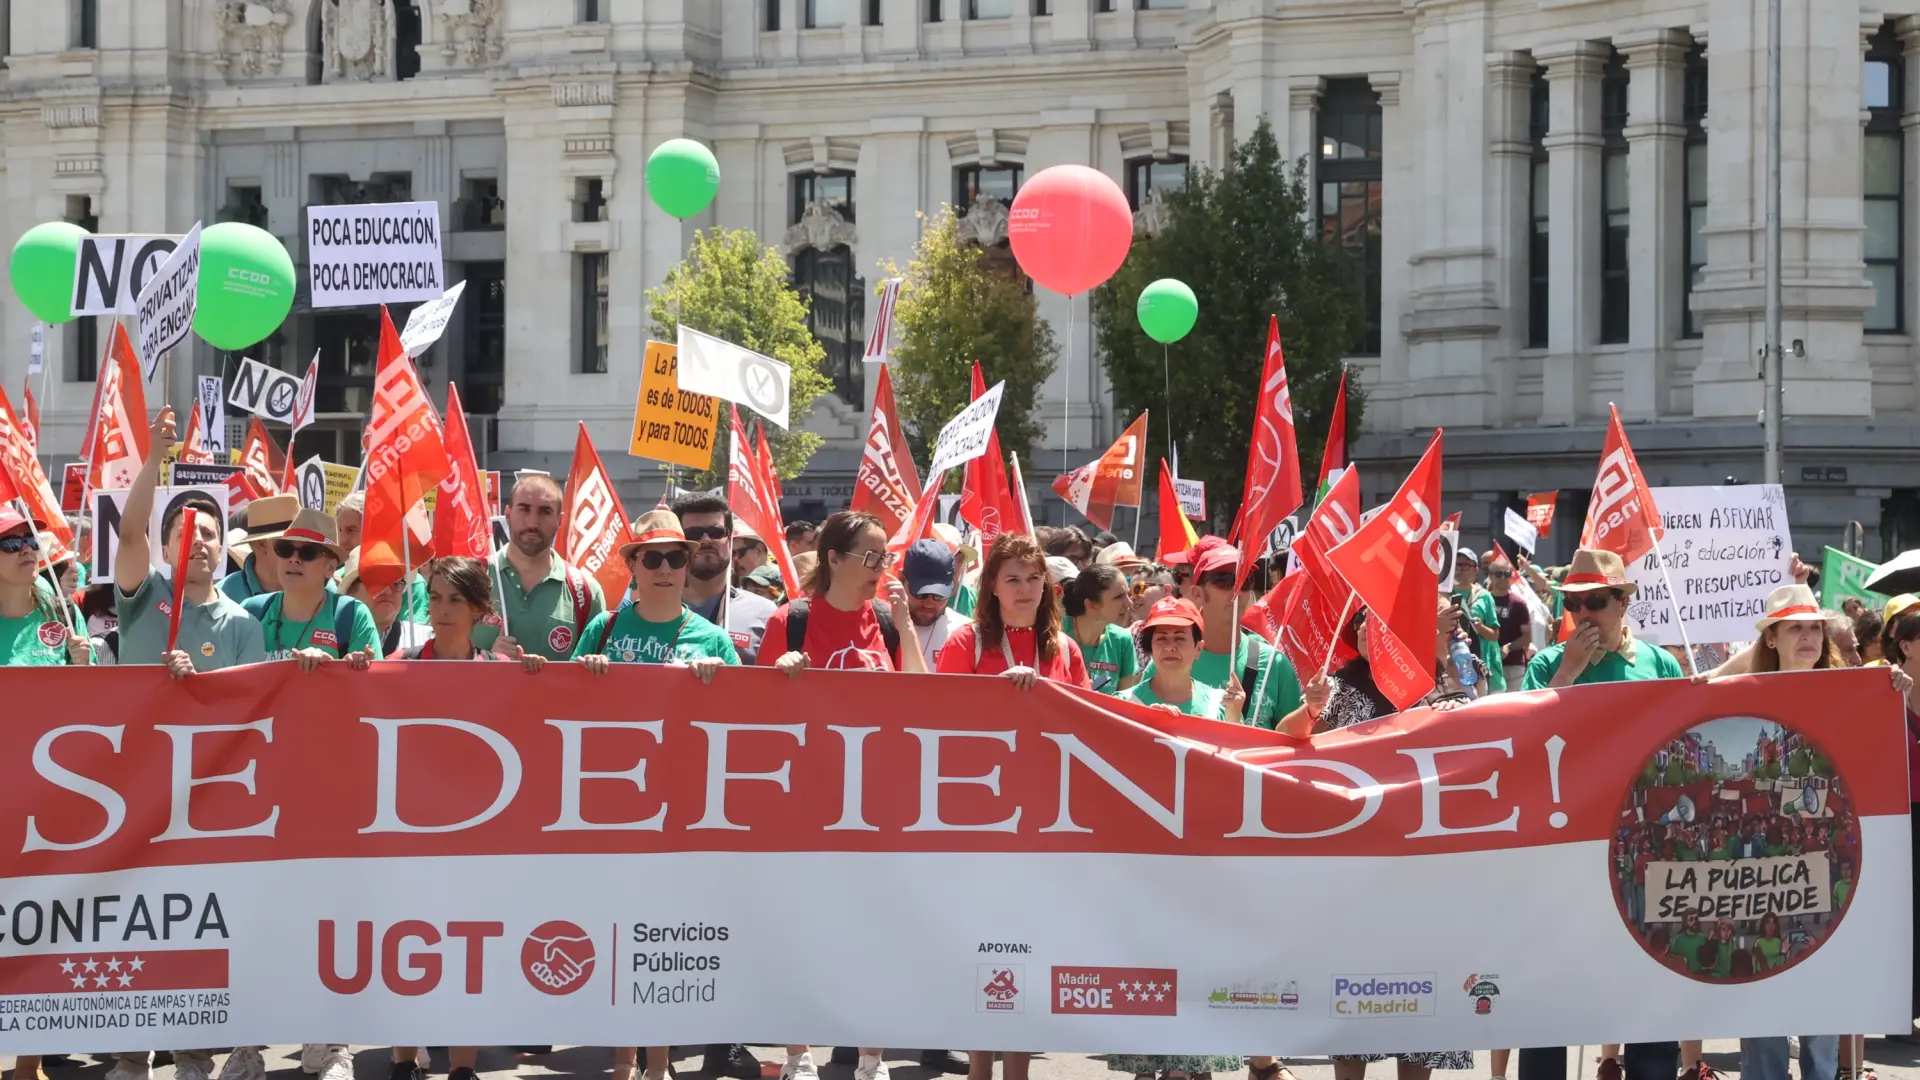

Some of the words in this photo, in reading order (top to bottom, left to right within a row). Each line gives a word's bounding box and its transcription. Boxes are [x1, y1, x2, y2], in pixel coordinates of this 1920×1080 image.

[312, 218, 352, 246] POCA
[354, 209, 438, 250] EDUCACIÓN,
[139, 243, 200, 334] PRIVATIZAN
[313, 263, 351, 291] POCA
[353, 261, 439, 291] DEMOCRACIA.
[142, 331, 159, 368] PARA
[654, 352, 668, 375] La
[647, 387, 659, 407] es
[660, 386, 674, 410] de
[677, 389, 713, 422] TODOS,
[637, 419, 647, 442] y
[646, 420, 671, 443] para
[673, 421, 709, 451] TODOS.
[1661, 511, 1701, 530] UIEREN
[1698, 538, 1766, 561] educación
[1683, 569, 1782, 595] PRESUPUESTO
[1650, 608, 1670, 625] EN
[1679, 598, 1768, 622] CLIMATIZACI
[19, 715, 280, 855] SE
[356, 716, 1569, 839] DEFIENDE!
[1665, 867, 1697, 893] LA
[1707, 859, 1810, 892] PÚBLICA
[1658, 894, 1690, 919] SE
[1697, 886, 1819, 919] DEFIENDE
[0, 892, 230, 946] ONFAPA
[632, 921, 730, 944] Servicios
[317, 919, 505, 996] UGT
[977, 942, 1033, 954] APOYAN:
[632, 951, 721, 973] Públicos
[632, 978, 717, 1004] Madrid
[1058, 972, 1101, 986] Madrid
[1334, 978, 1434, 997] Podemos
[0, 995, 60, 1014] EDERACIÓN
[63, 992, 132, 1011] AUTONÓMICA
[134, 995, 149, 1010] DE
[150, 994, 186, 1009] AMPAS
[187, 994, 196, 1008] Y
[197, 992, 231, 1008] FAPAS
[987, 1002, 1014, 1010] MADRID
[1059, 987, 1114, 1009] PSOE
[1335, 1000, 1353, 1014] C.
[1357, 998, 1419, 1014] Madrid
[25, 1013, 130, 1031] COMUNIDAD
[135, 1012, 157, 1028] DE
[163, 1010, 229, 1027] MADRID
